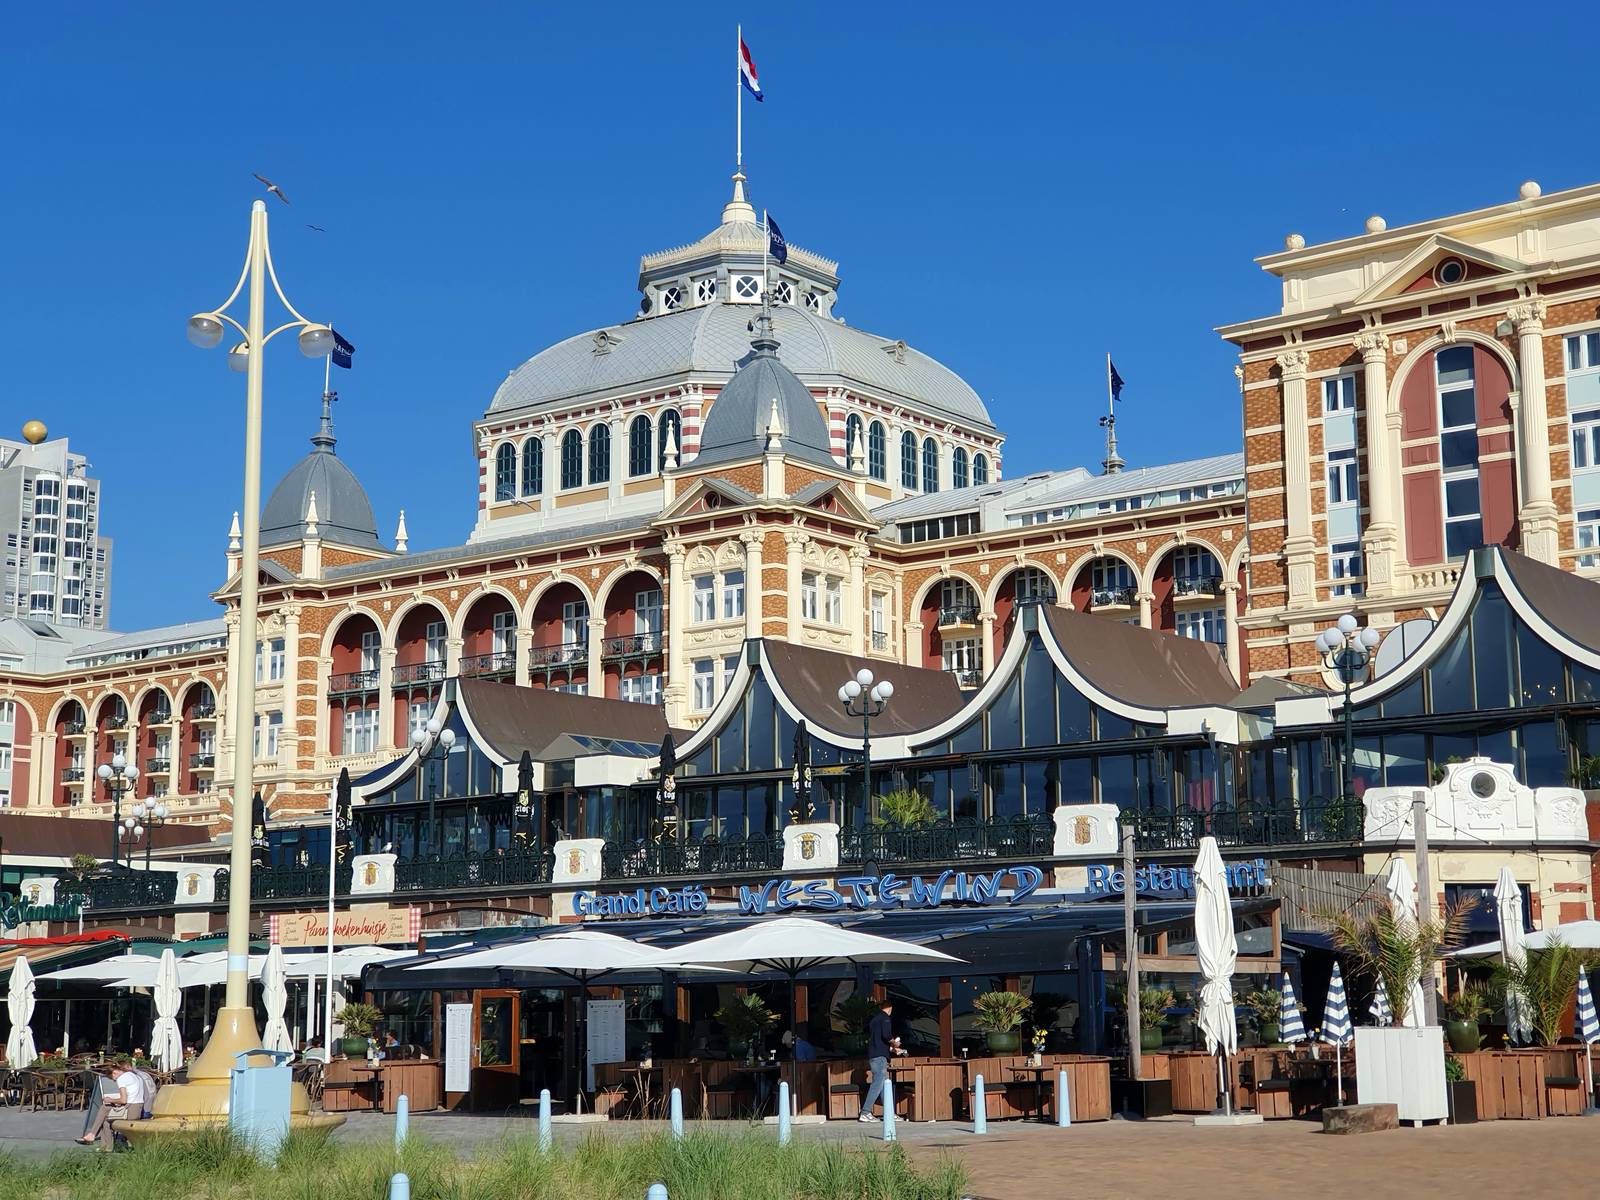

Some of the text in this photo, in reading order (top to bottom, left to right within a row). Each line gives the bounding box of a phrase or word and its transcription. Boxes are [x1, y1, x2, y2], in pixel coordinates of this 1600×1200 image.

[739, 865, 1044, 914] WESTEWIND
[1086, 858, 1266, 894] Restaunt
[572, 884, 709, 916] Grand Café
